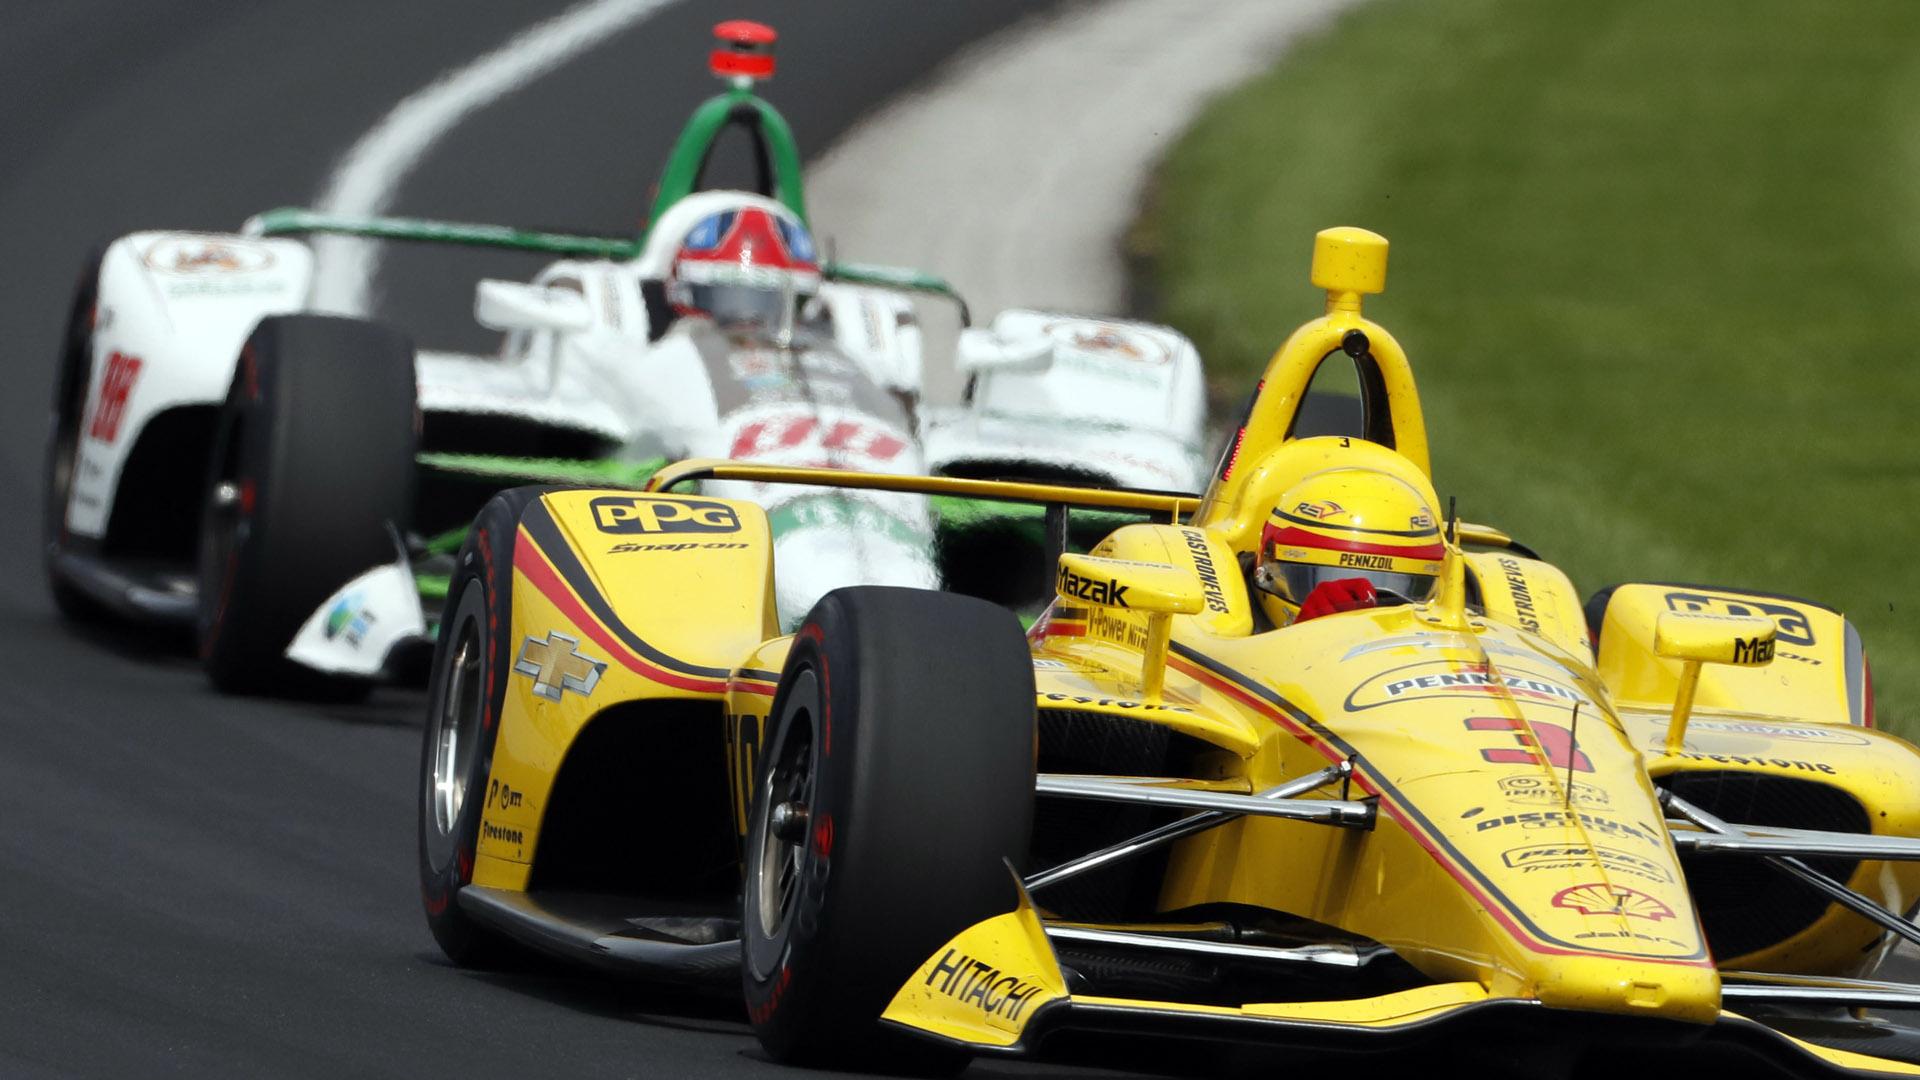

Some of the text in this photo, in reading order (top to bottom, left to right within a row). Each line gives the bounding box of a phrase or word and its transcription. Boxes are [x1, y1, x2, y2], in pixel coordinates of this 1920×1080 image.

[1339, 437, 1350, 449] 3
[596, 500, 736, 532] PPG
[1182, 530, 1229, 614] CASTRONEVES
[1339, 553, 1394, 570] PENNZOIL
[1059, 564, 1131, 608] Mazak
[1499, 558, 1540, 634] ASTRONEVES
[1384, 673, 1583, 700] PENNZOIL
[1463, 717, 1596, 774] 3
[483, 821, 523, 844] Firestone
[1476, 811, 1660, 847] DISCOUNT
[925, 948, 1043, 1021] HITACHI
